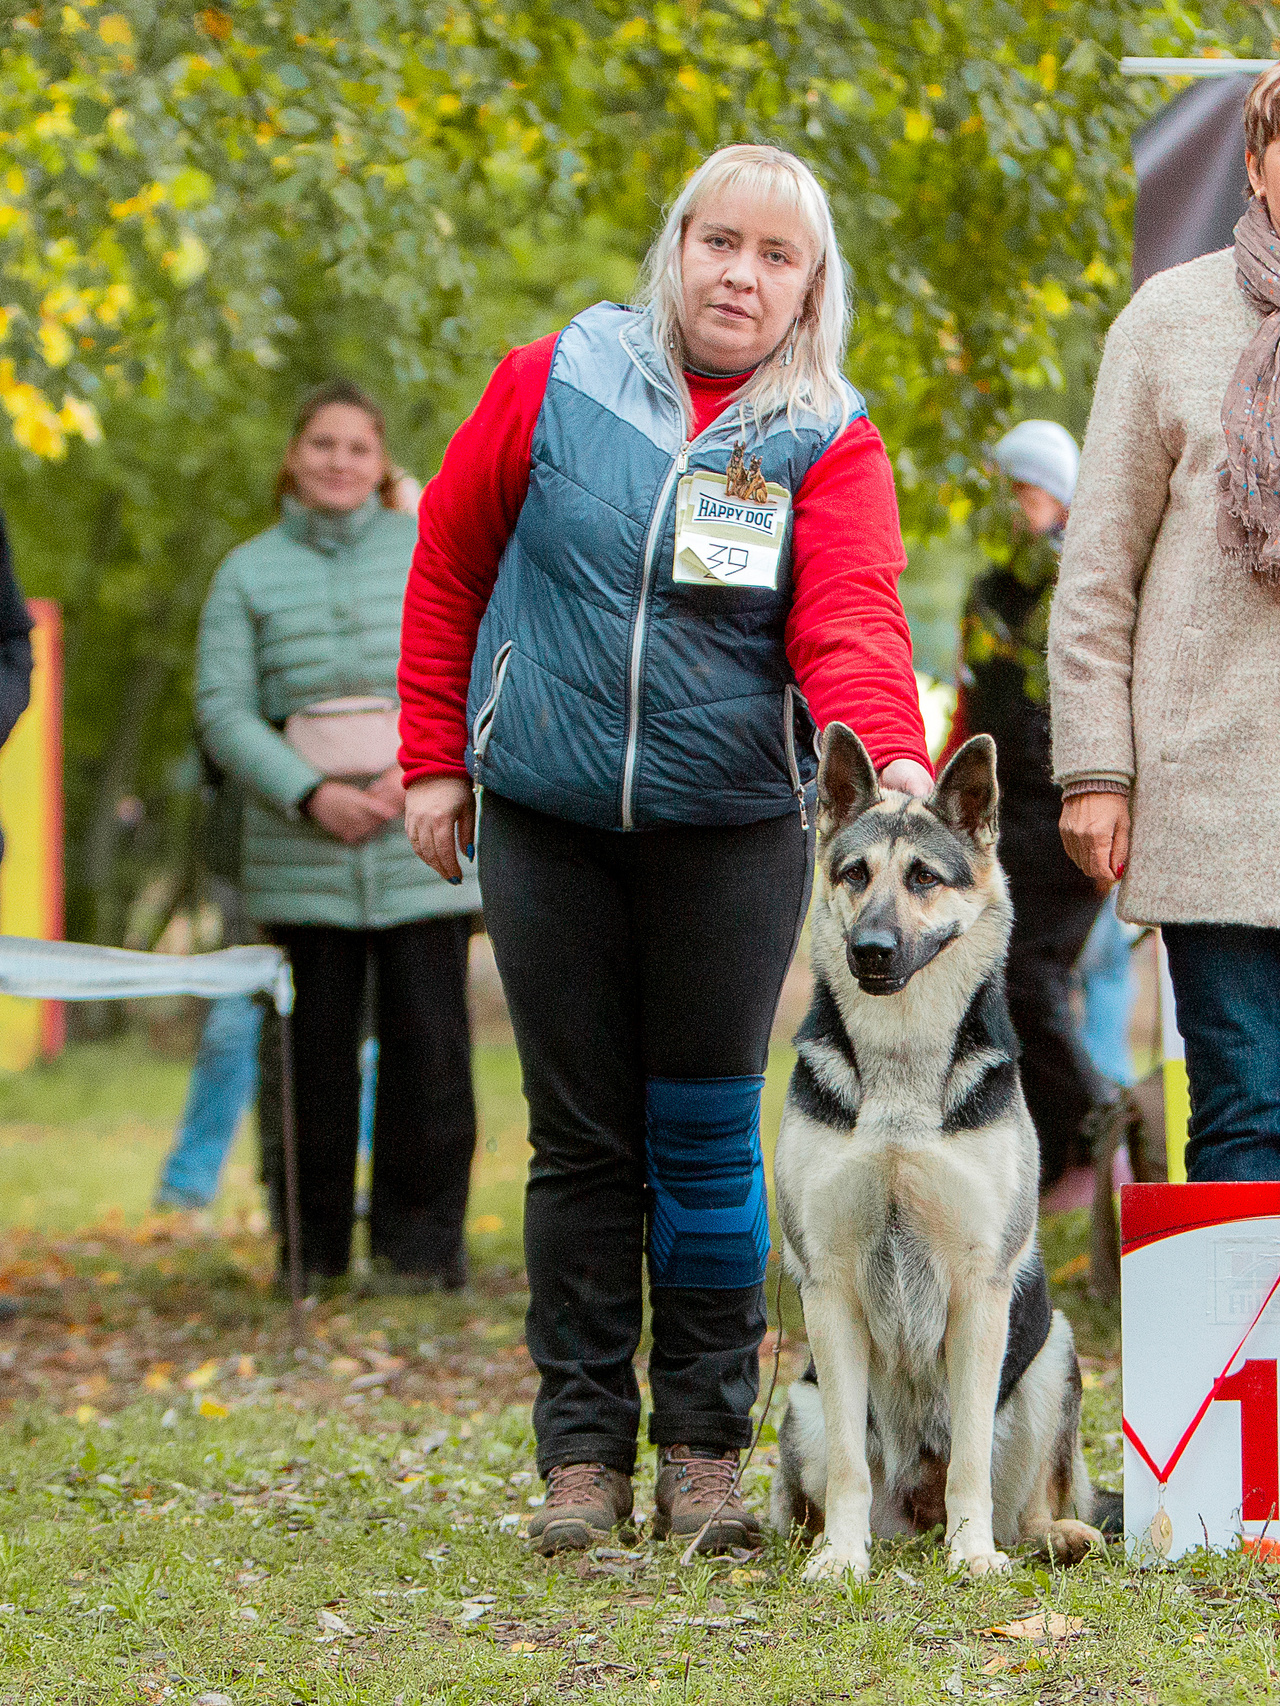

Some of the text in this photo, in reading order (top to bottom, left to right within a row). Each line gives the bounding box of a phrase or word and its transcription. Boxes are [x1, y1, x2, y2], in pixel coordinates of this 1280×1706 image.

[697, 497, 774, 529] HAPPY DOG
[706, 543, 749, 576] 39
[1213, 1357, 1280, 1522] 1
